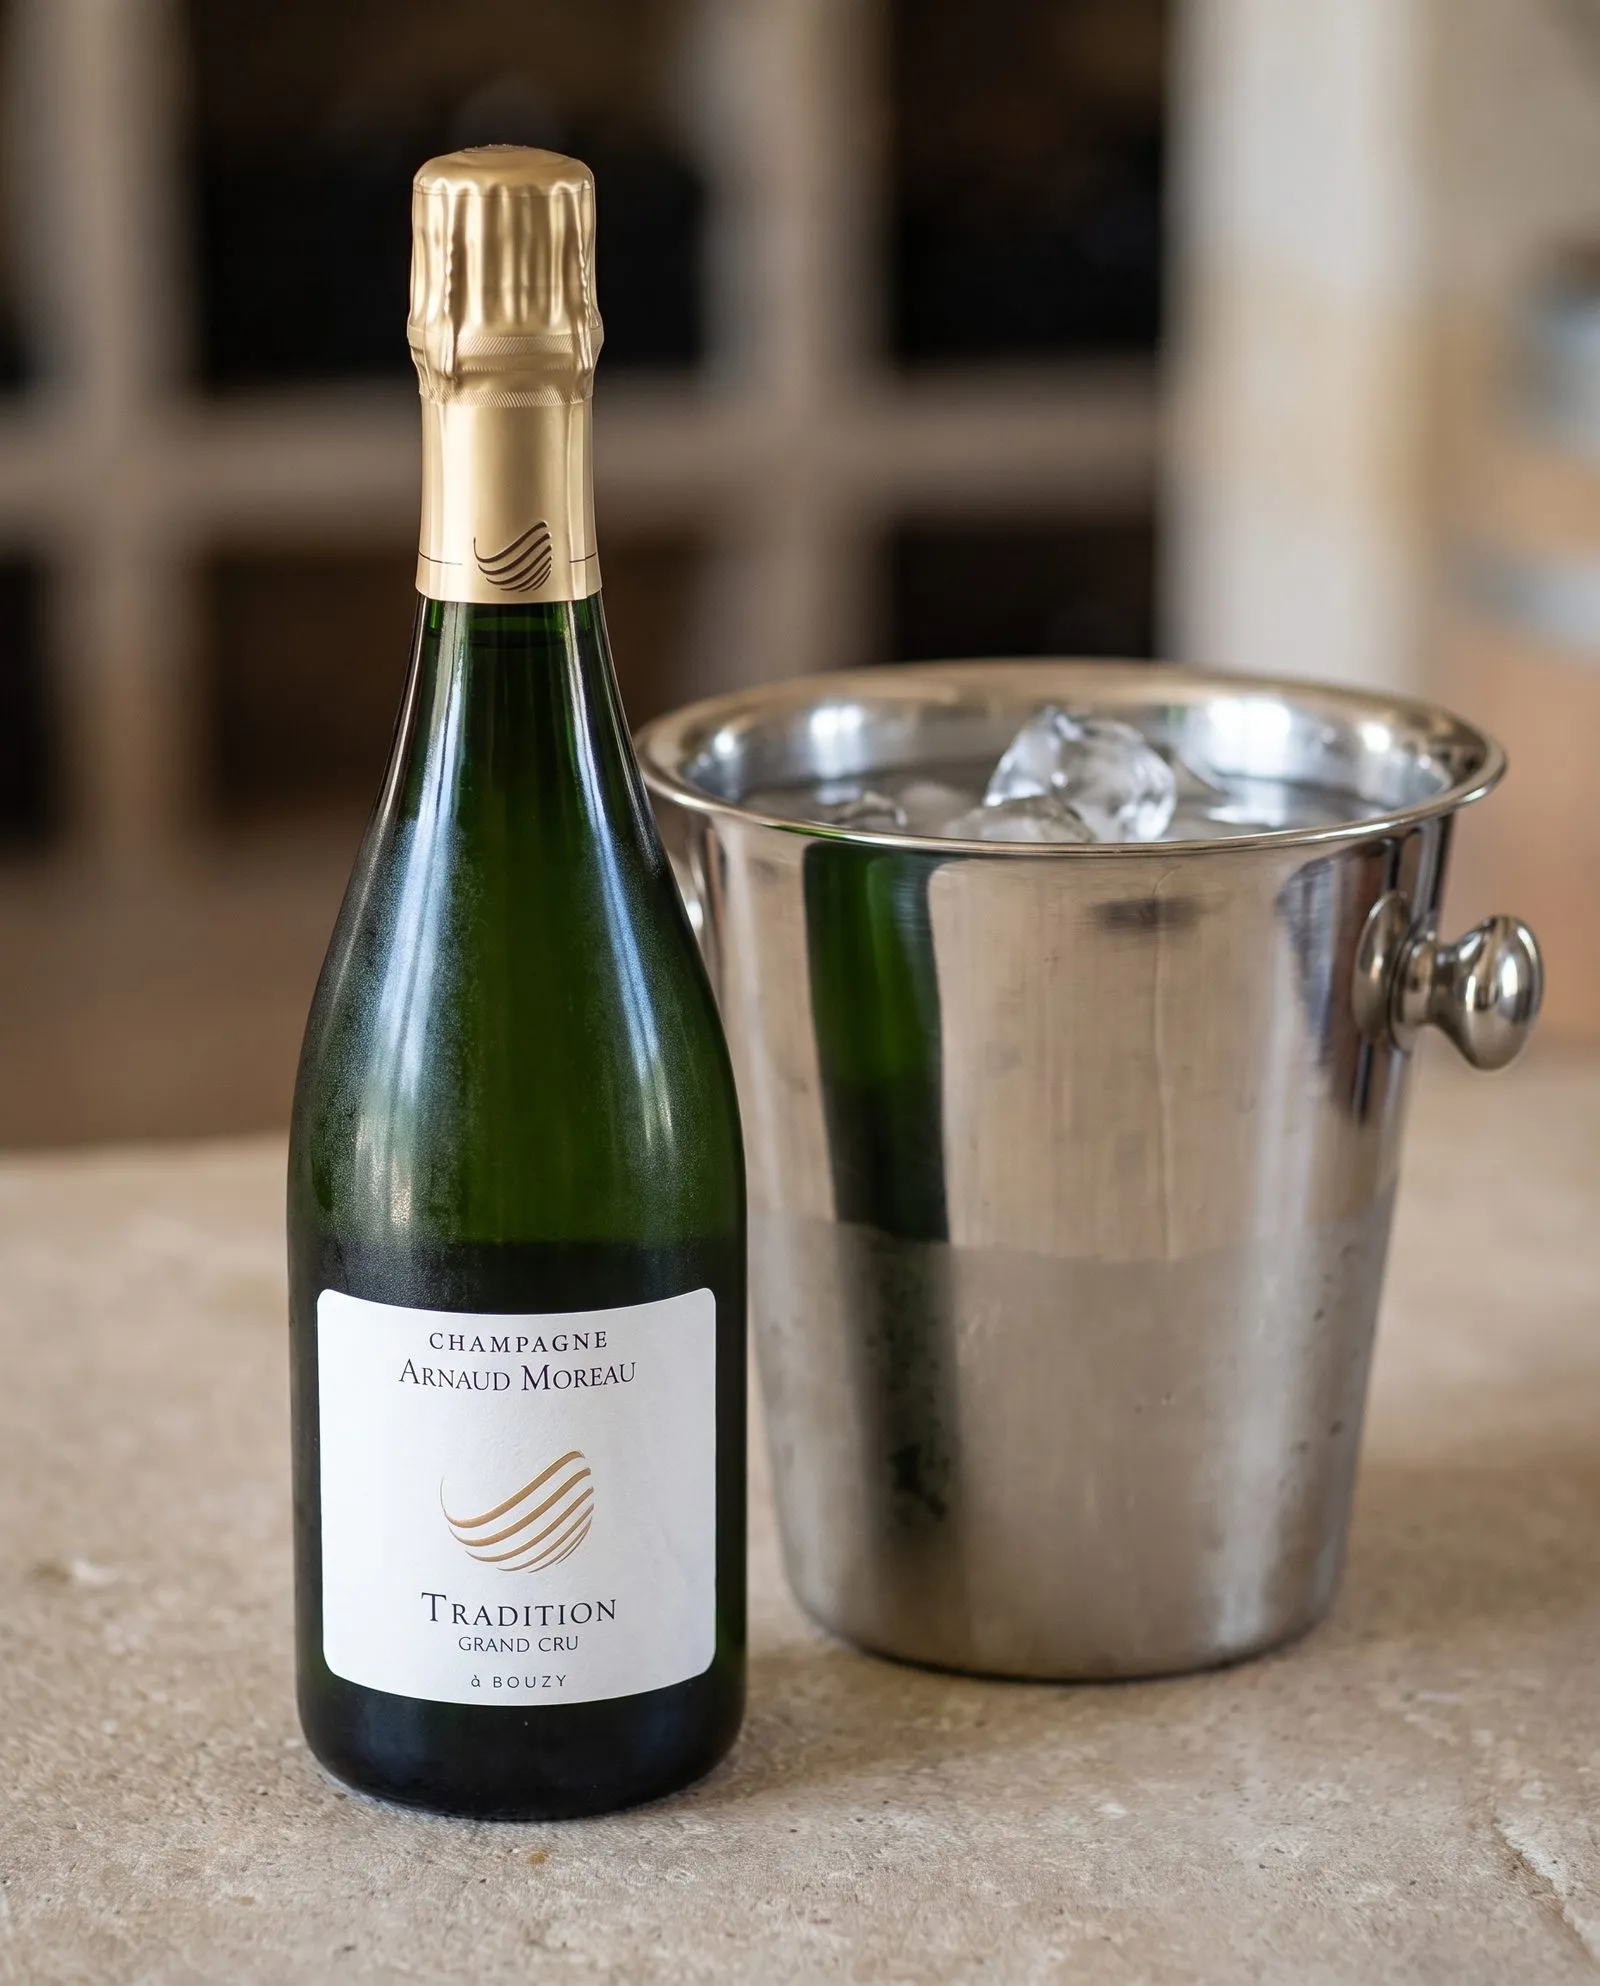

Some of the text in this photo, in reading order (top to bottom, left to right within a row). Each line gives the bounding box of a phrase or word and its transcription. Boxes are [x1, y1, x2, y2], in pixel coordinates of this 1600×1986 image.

[429, 1330, 609, 1354] CHAMPAGNE
[398, 1358, 637, 1392] ARNAUD MOREAU
[421, 1591, 617, 1627] TRADITION
[458, 1635, 579, 1653] GRAND CRU
[470, 1673, 567, 1689] à BOUZY
